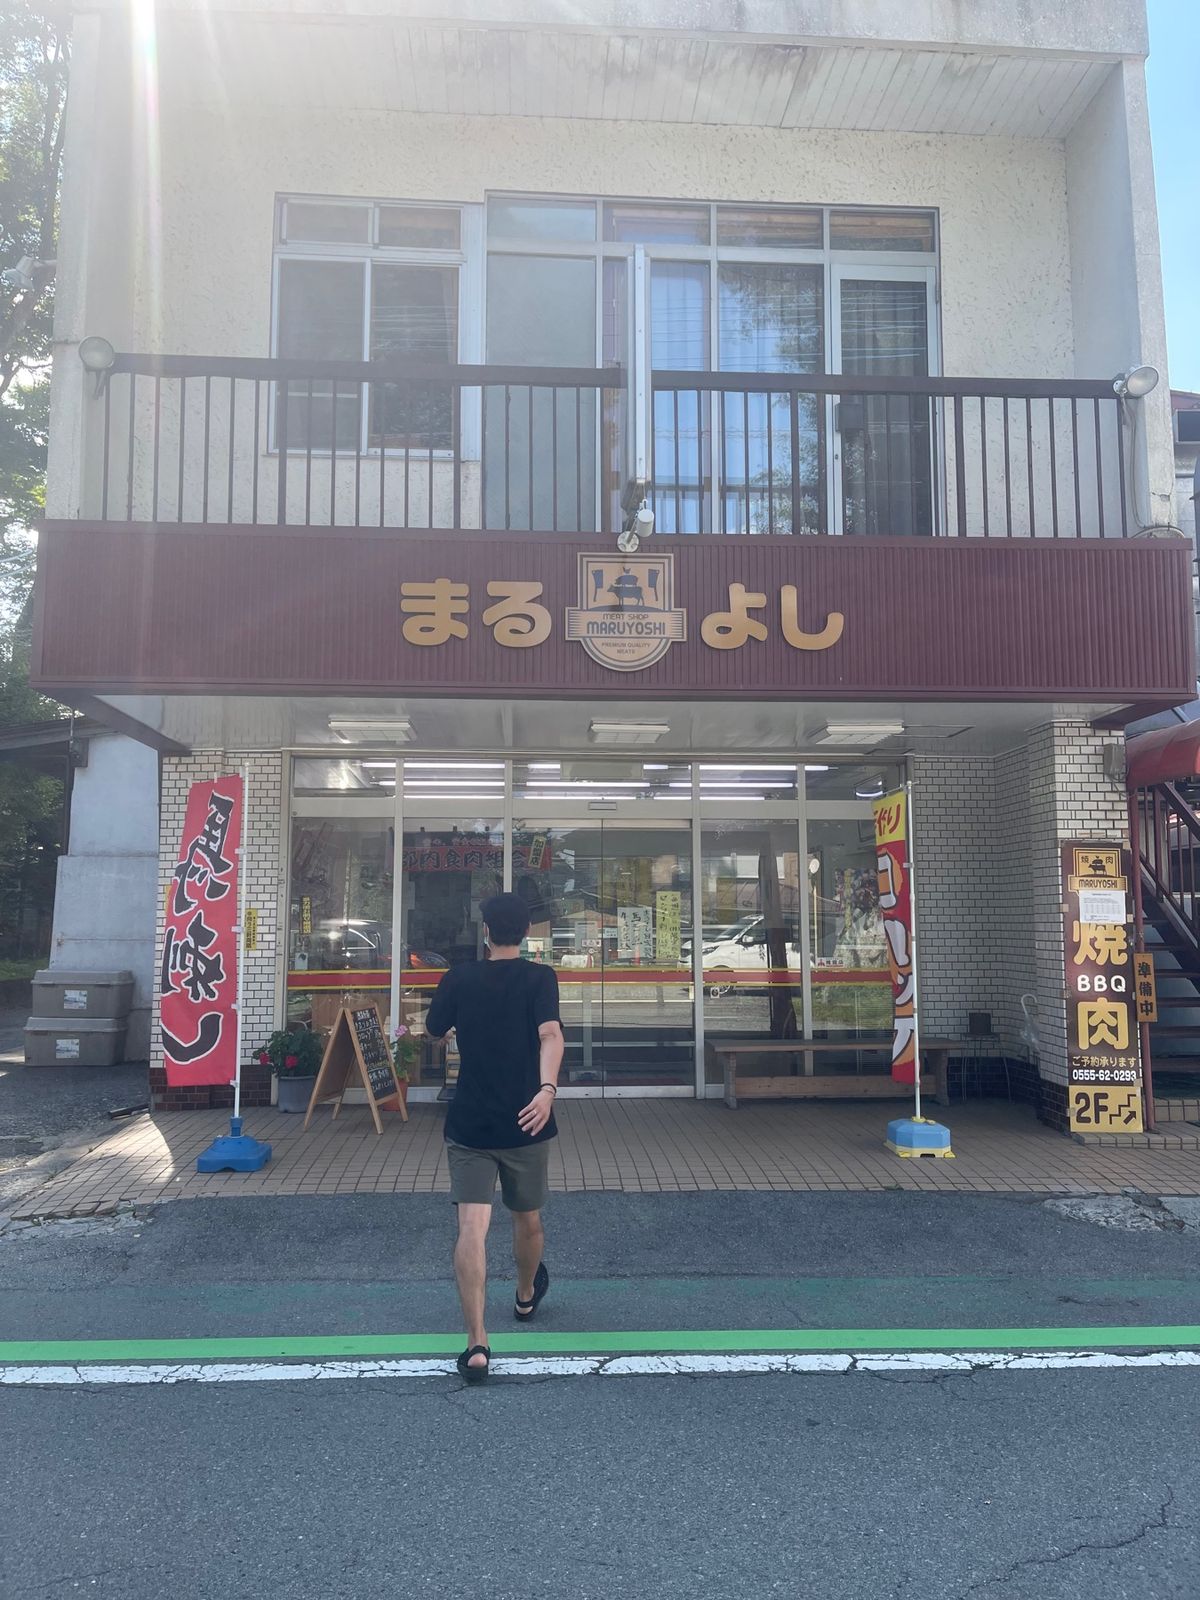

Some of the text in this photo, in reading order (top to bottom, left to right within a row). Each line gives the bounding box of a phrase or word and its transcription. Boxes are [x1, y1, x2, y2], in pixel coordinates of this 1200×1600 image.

[400, 577, 845, 651] まる よし
[602, 613, 625, 621] MEAT
[586, 621, 666, 636] MARUYOSHI
[1105, 856, 1114, 864] 肉
[1078, 879, 1118, 888] MARUYOSHI
[1072, 920, 1128, 966] 焼
[1077, 975, 1126, 993] BBQ
[1137, 962, 1154, 1016] 準備中
[1077, 997, 1130, 1050] 肉
[1072, 1055, 1137, 1068] ご予約承ります
[1072, 1069, 1137, 1082] 0555-62-0293
[1074, 1091, 1109, 1124] 2F
